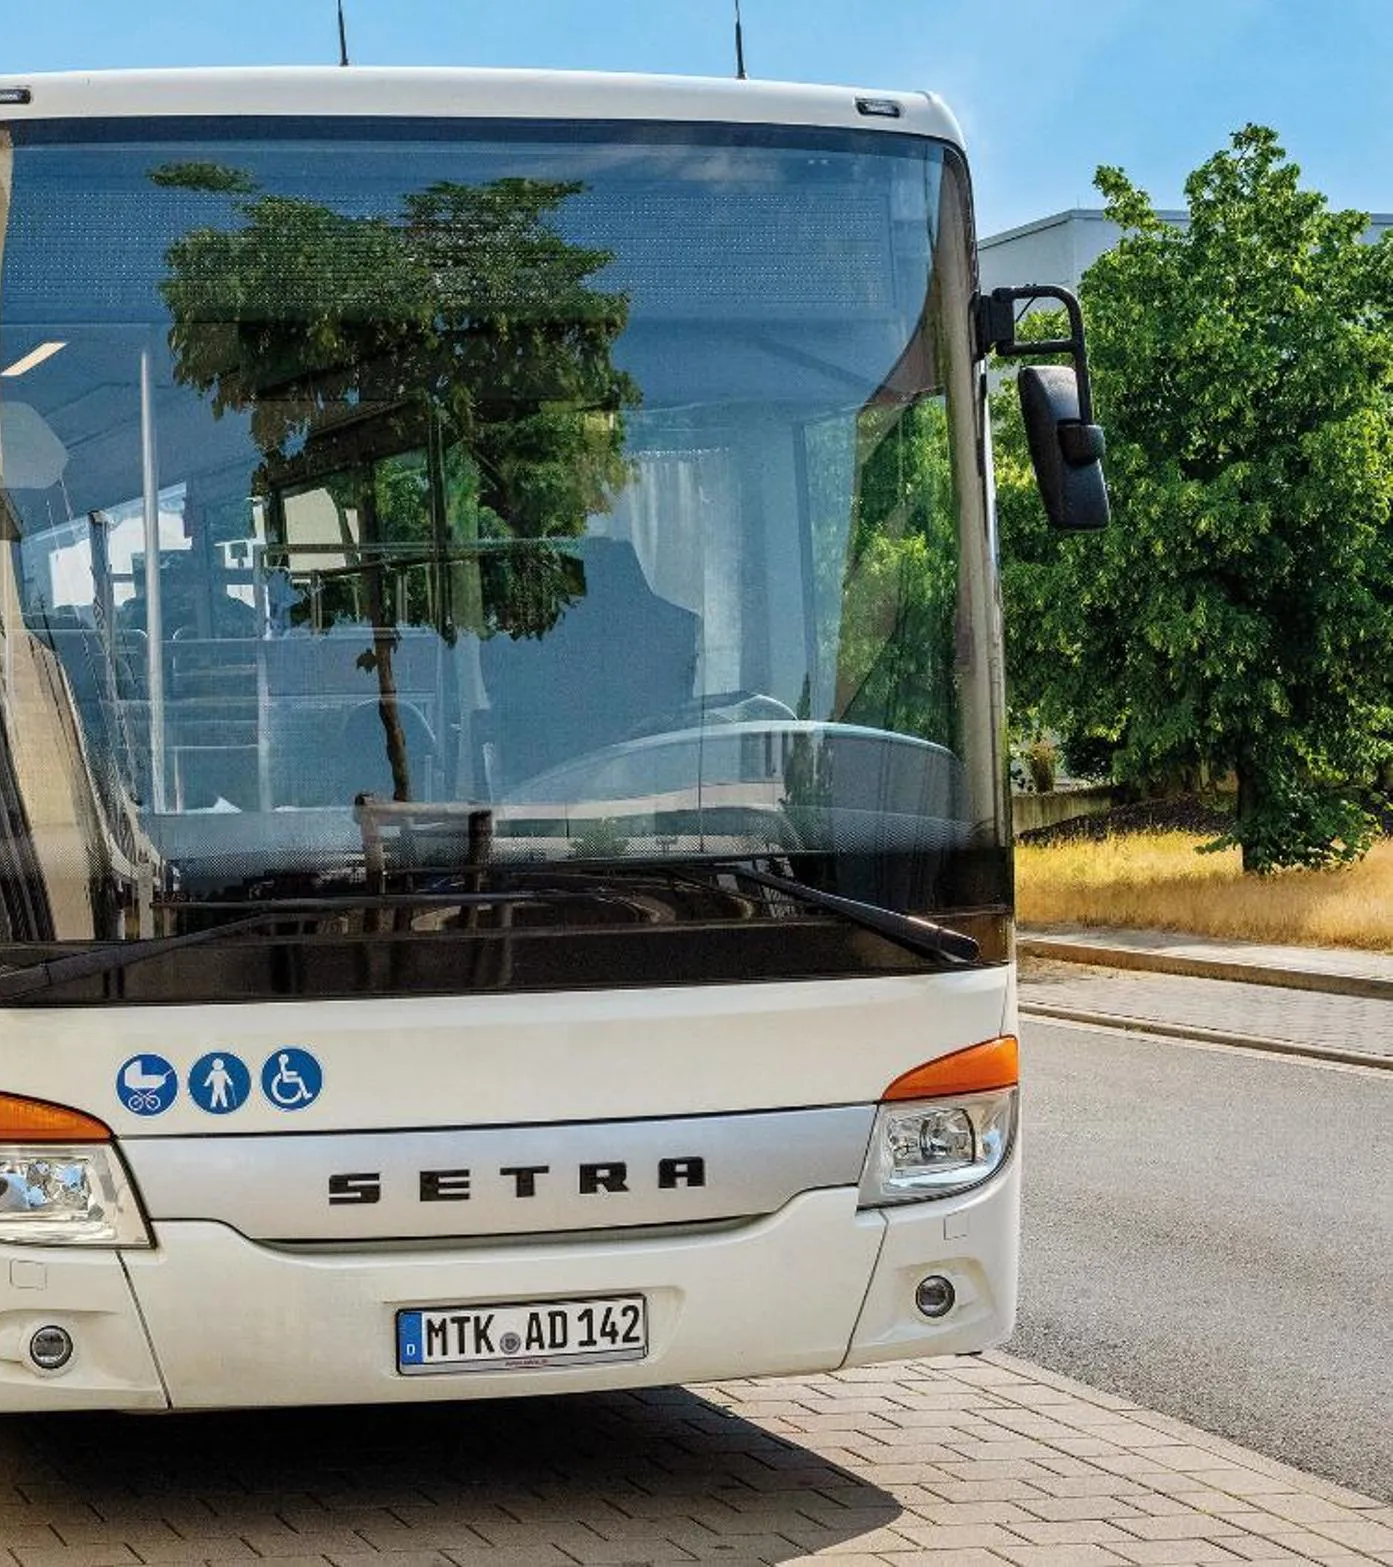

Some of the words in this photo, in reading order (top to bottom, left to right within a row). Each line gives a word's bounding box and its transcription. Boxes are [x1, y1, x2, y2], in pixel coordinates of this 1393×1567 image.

[329, 1156, 706, 1205] SETRA
[427, 1314, 495, 1357] MTK
[525, 1311, 568, 1350] AD
[578, 1305, 640, 1347] 142
